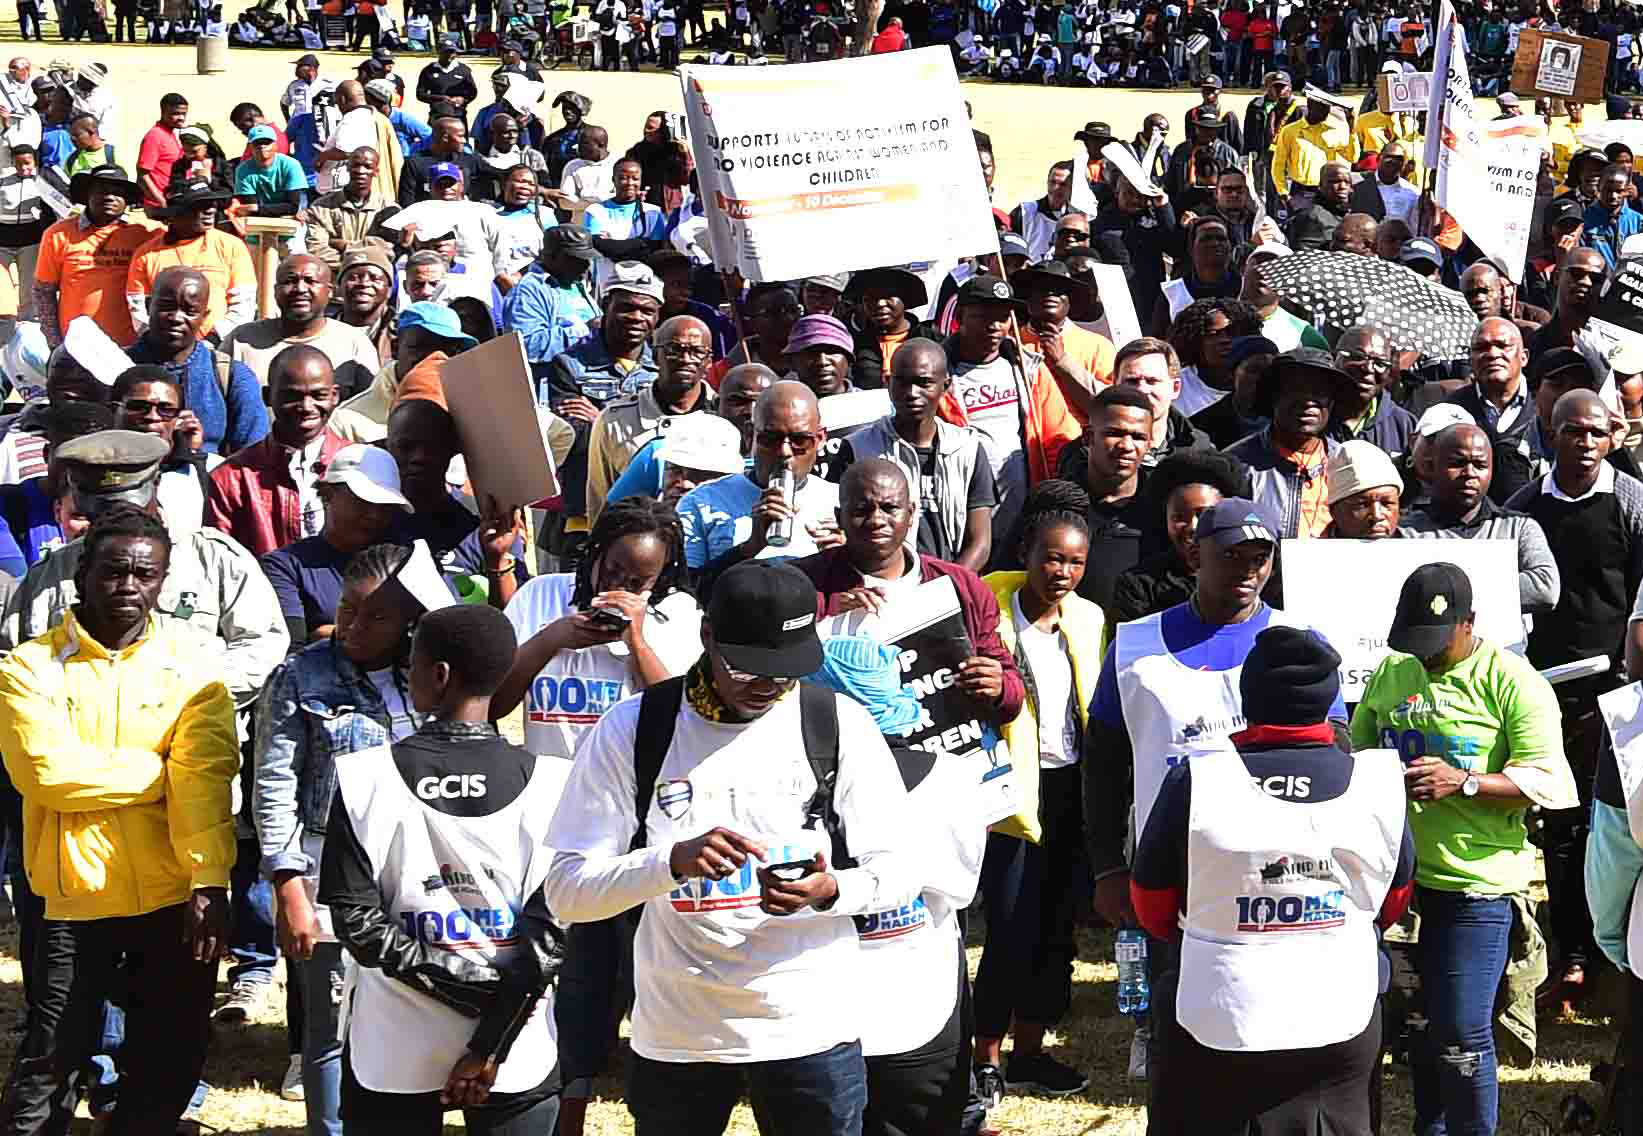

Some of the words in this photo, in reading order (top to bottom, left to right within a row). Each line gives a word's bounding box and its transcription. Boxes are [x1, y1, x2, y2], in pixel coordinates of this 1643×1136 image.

[922, 117, 950, 131] FOR
[740, 151, 812, 170] VIOLENCE
[809, 167, 881, 185] CHILDREN
[416, 774, 487, 800] GCIS
[880, 895, 925, 920] MEN
[1235, 895, 1303, 925] 100
[1303, 889, 1346, 912] MEN
[400, 910, 472, 942] 100
[880, 911, 925, 930] MARCH
